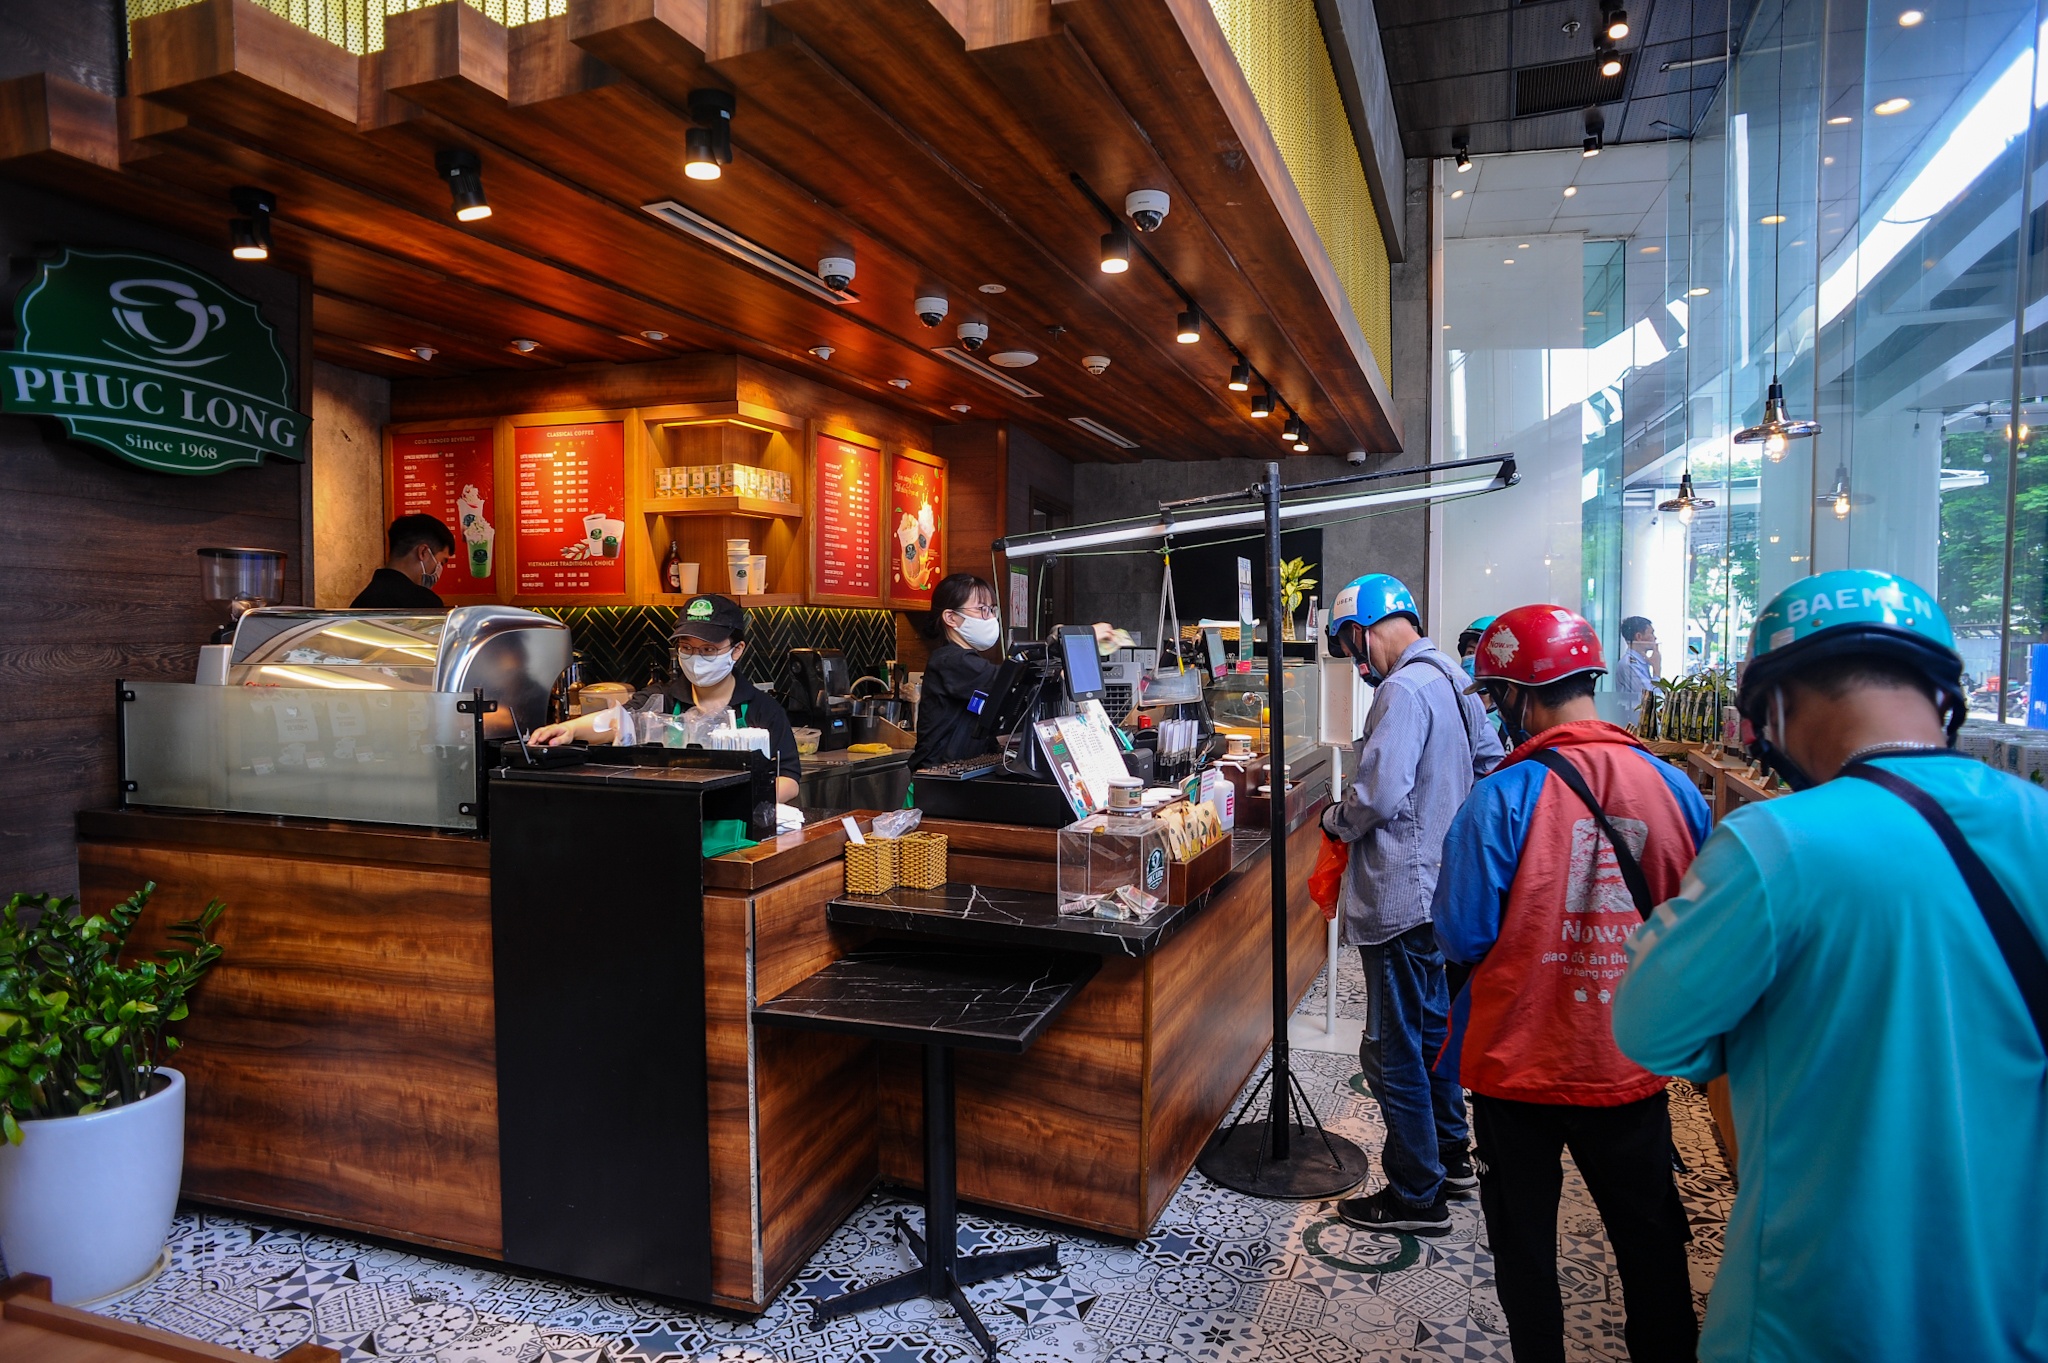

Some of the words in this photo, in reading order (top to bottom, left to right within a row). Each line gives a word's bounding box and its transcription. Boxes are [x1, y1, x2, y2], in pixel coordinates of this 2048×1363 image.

[9, 366, 165, 415] PHUC
[180, 389, 296, 448] LONG
[546, 430, 573, 438] CLASSICAL
[125, 433, 173, 453] Since
[179, 442, 218, 460] 1968
[1336, 597, 1353, 606] UBER
[1787, 586, 1932, 624] BAEMIN
[1541, 951, 1568, 964] Giao
[1589, 953, 1608, 965] ăn
